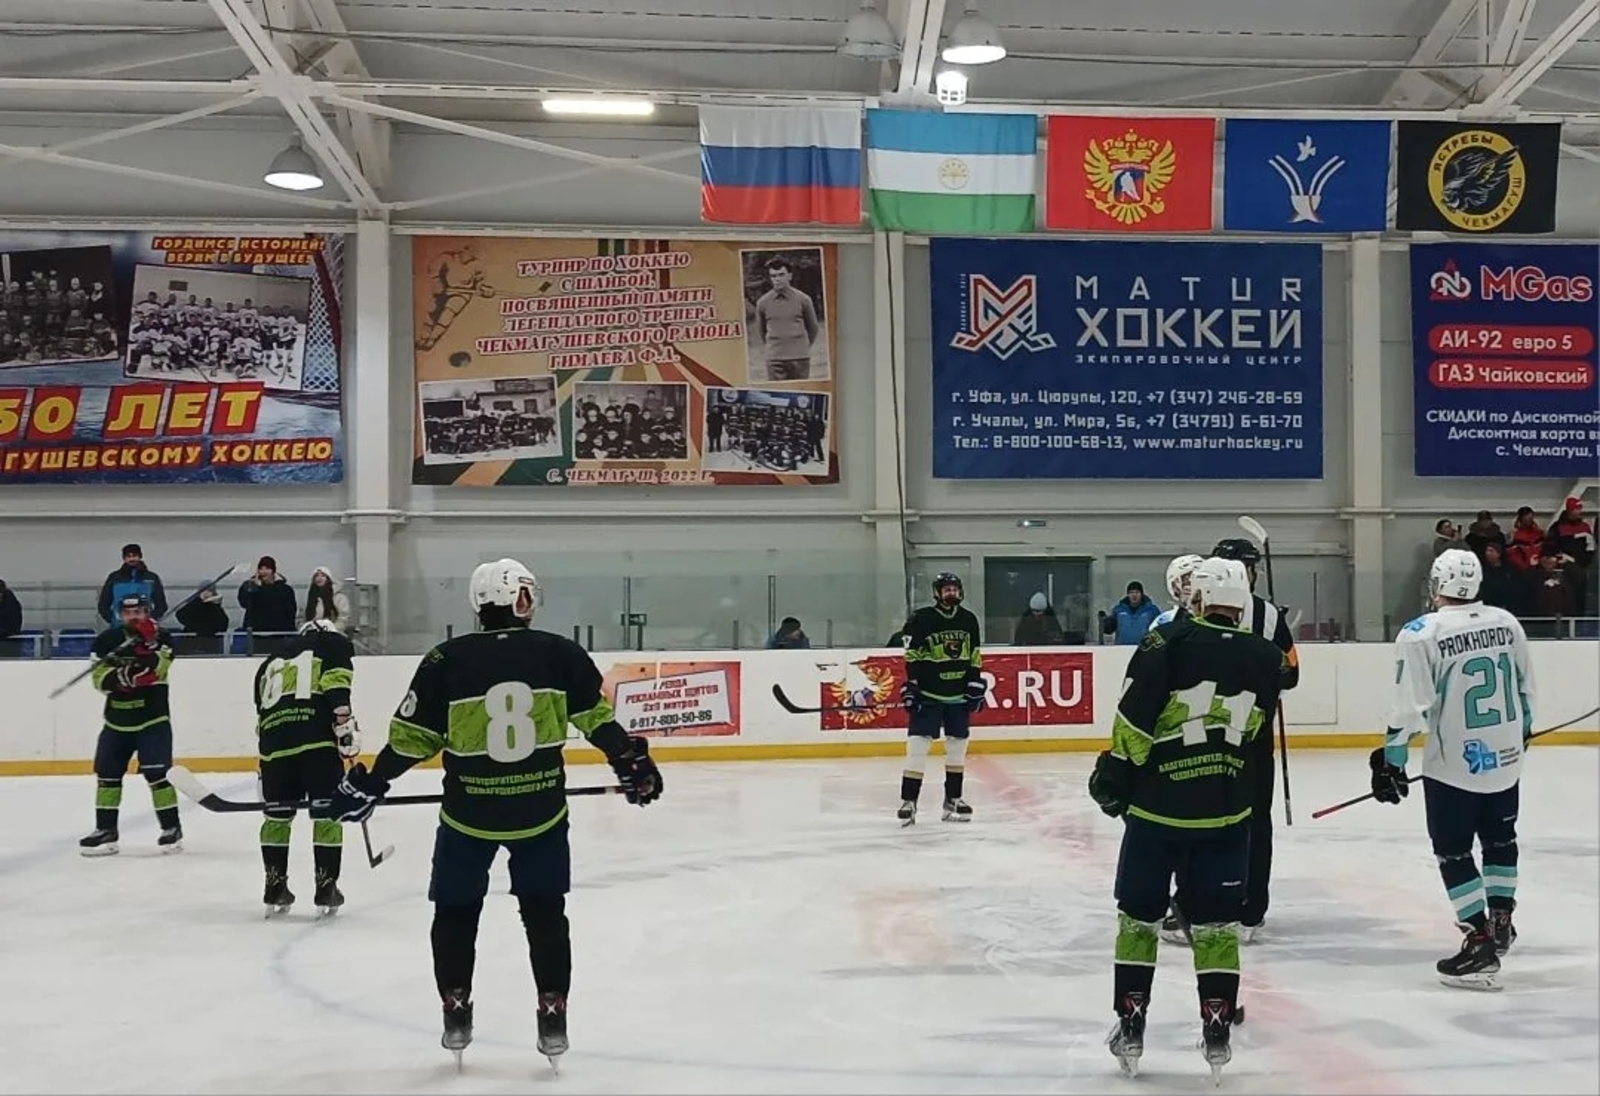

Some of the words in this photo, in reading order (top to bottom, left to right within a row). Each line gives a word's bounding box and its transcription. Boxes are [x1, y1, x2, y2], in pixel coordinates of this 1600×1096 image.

[1434, 134, 1493, 172] ЯСТРЕБЫ
[1462, 177, 1522, 227] ЧЕКМАГУШ
[154, 238, 235, 249] ГОРДИМСЯ
[240, 237, 325, 250] ИСТОРИЕЙ!
[167, 252, 216, 263] ВЕРИМ
[233, 252, 310, 264] БУДУЩЕЕ!
[519, 260, 586, 275] ТУРНИР
[590, 258, 613, 271] ПО
[618, 254, 689, 269] ХОККЕЮ
[561, 279, 572, 291] С
[1076, 276, 1301, 301] MATUR
[1480, 265, 1593, 302] MGas
[502, 291, 640, 313] ПОСВЯЩЕННЫЙ
[643, 289, 712, 304] ПАМЯТИ
[506, 311, 637, 331] ЛЕГЕНДАРНОГО
[642, 307, 716, 322] ТРЕНЕРА
[1076, 308, 1301, 348] ХОККЕЙ
[478, 329, 664, 353] ЧЕКМАГУШЕВСКОГО
[669, 322, 741, 340] РАЙОНА
[1439, 331, 1502, 348] АИ-92
[1512, 337, 1556, 352] евро
[1562, 335, 1573, 350] 5
[550, 351, 634, 368] ГИМАЕВА
[1438, 364, 1474, 382] ГАЗ
[1479, 367, 1588, 384] Чайковский
[952, 392, 964, 402] г.
[969, 390, 1007, 404] Уфа,
[1011, 392, 1033, 404] ул.
[1038, 390, 1105, 405] Цюрупы,
[1110, 391, 1142, 405] 120,
[1147, 391, 1165, 404] +7
[1170, 389, 1213, 405] (347)
[1218, 391, 1302, 404] 246-28-69
[0, 396, 75, 433] 50
[108, 390, 260, 431] ЛЕТ
[953, 416, 965, 427] г.
[971, 414, 1028, 429] Учалы,
[1034, 416, 1058, 429] ул.
[1064, 414, 1110, 429] Мира,
[1147, 414, 1165, 427] +7
[1172, 413, 1235, 429] (34791)
[1241, 415, 1302, 428] 6-61-70
[1426, 410, 1486, 423] СКИДКИ
[1490, 413, 1508, 423] по
[953, 436, 989, 448] Тел.:
[993, 436, 1128, 450] 8-800-100-68-13,
[1133, 436, 1303, 450] www.maturhockey.ru
[1448, 427, 1537, 440] Дисконтная
[1541, 430, 1585, 442] карта
[5, 446, 200, 470] ГУШЕВСКОМУ
[211, 441, 332, 463] ХОККЕЮ
[1496, 445, 1510, 456] с.
[662, 470, 698, 482] 2022
[1462, 652, 1516, 729] 21
[484, 681, 537, 763] 8
[1176, 680, 1257, 747] 11
